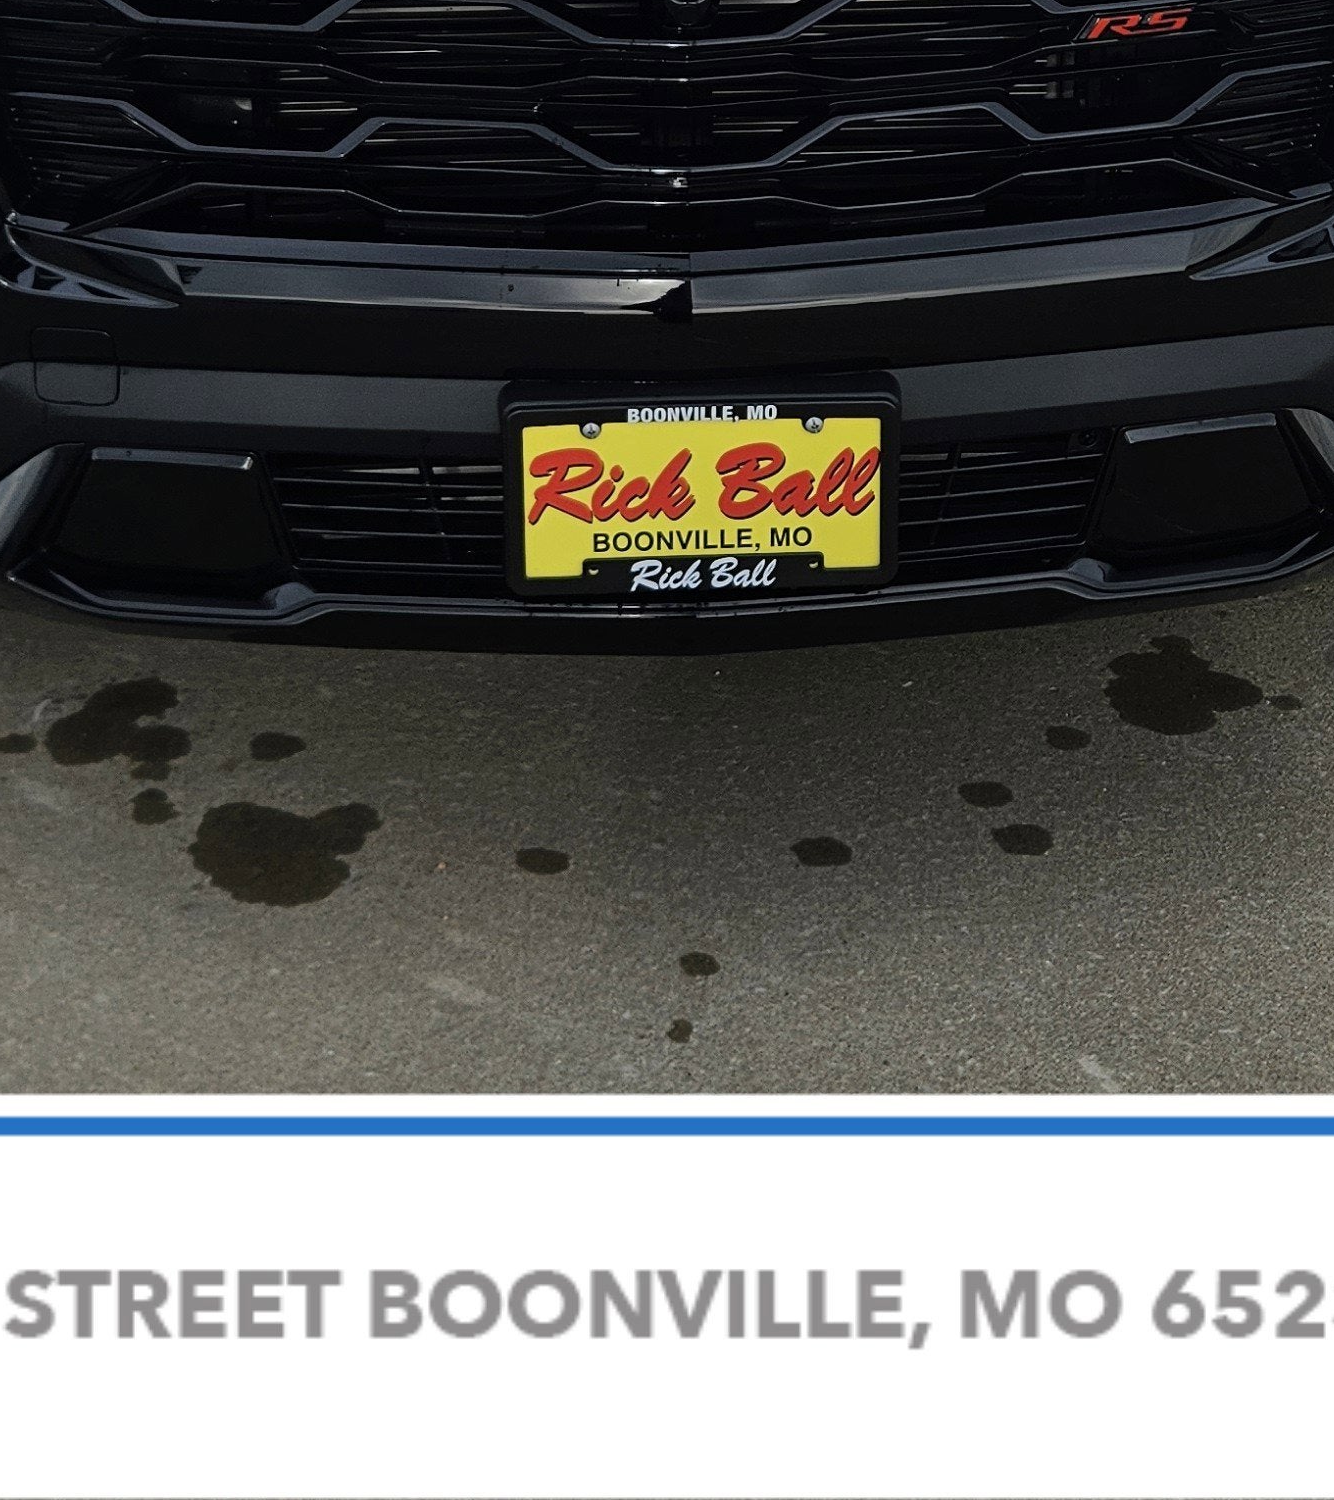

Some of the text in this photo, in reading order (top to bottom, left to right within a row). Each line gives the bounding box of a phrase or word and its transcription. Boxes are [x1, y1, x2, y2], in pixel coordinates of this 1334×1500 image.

[1087, 7, 1194, 39] RS
[627, 404, 778, 423] BOONVILLE, MO
[528, 442, 880, 524] Rick Ball
[593, 526, 813, 553] BOONVILLE, MO
[630, 556, 777, 592] Rick Ball
